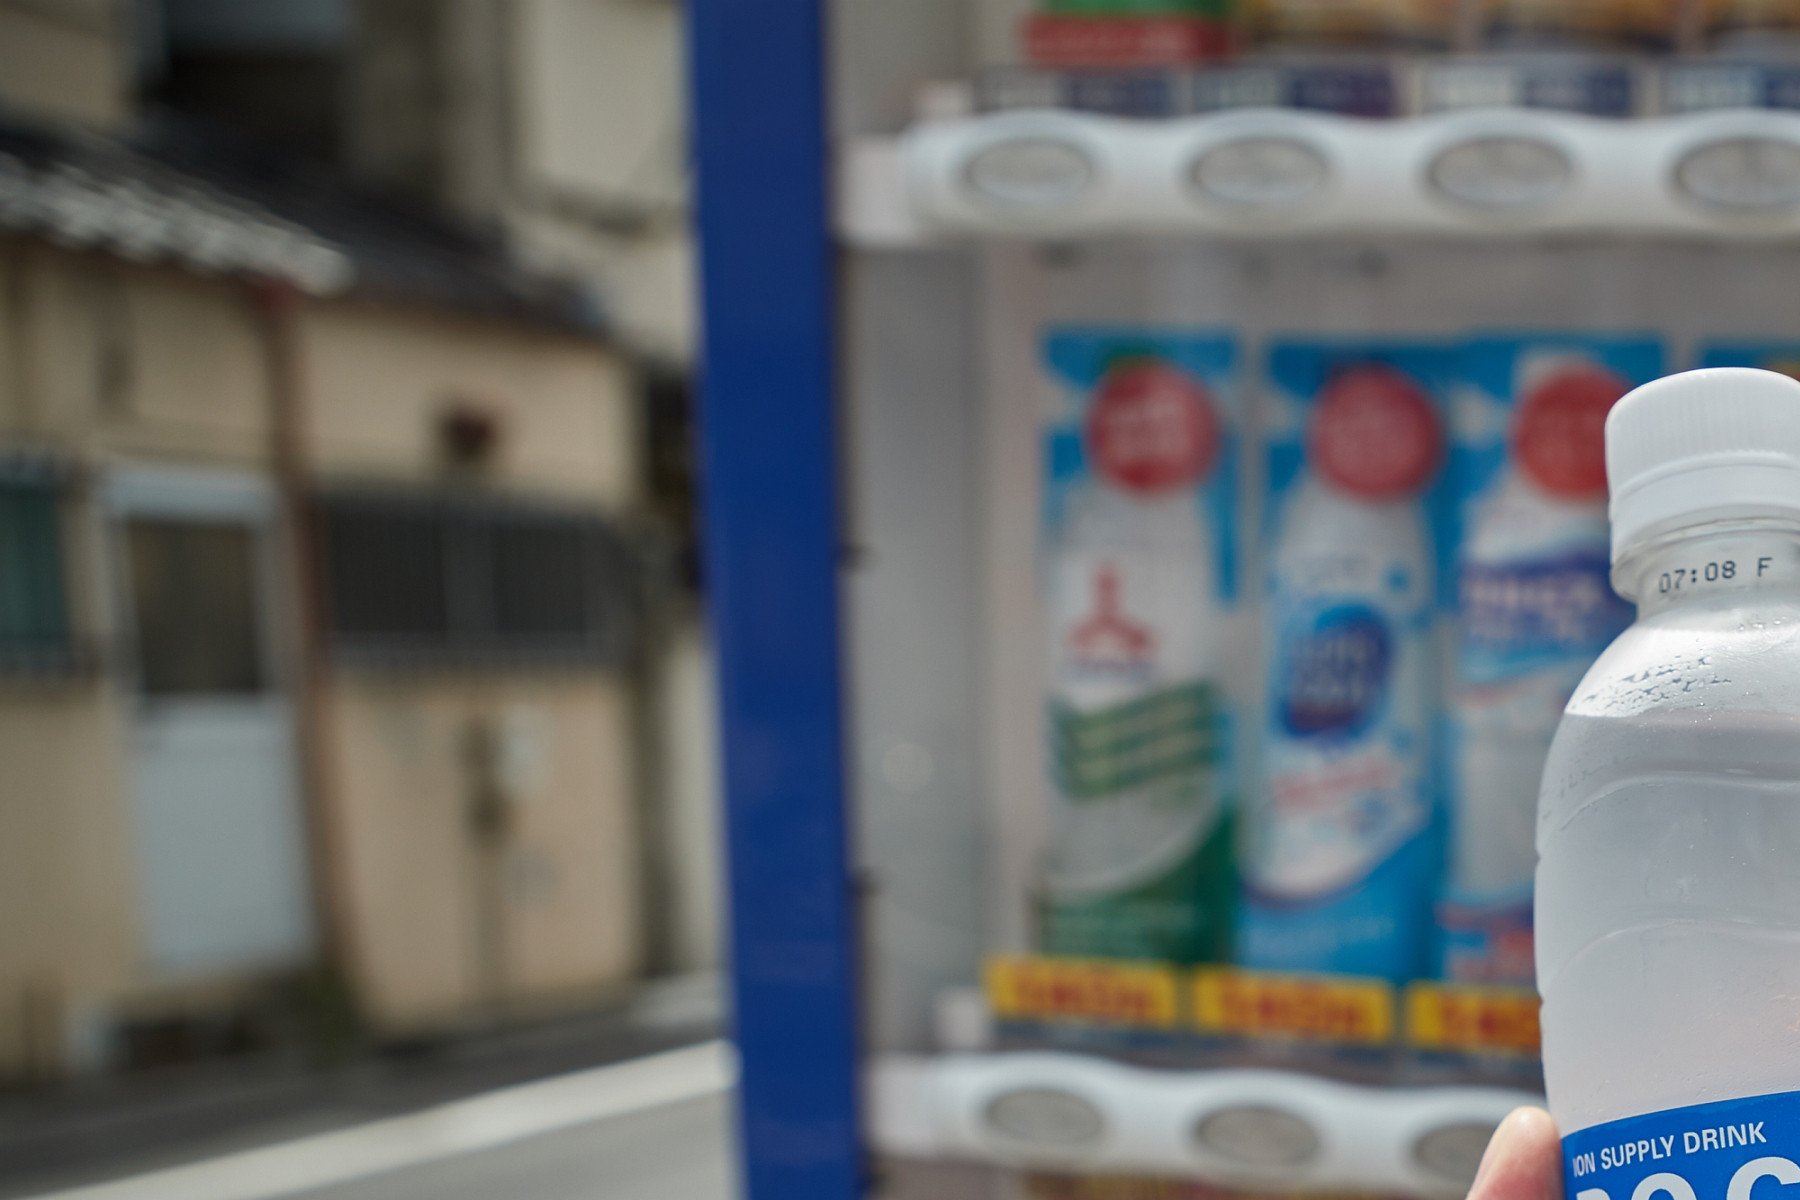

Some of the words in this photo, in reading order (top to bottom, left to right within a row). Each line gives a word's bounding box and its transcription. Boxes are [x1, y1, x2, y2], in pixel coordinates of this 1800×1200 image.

[1659, 560, 1736, 593] 07:08
[1757, 557, 1773, 577] F
[1572, 1151, 1596, 1178] ION
[1600, 1135, 1675, 1170] SUPPLY
[1683, 1121, 1767, 1154] DRINK
